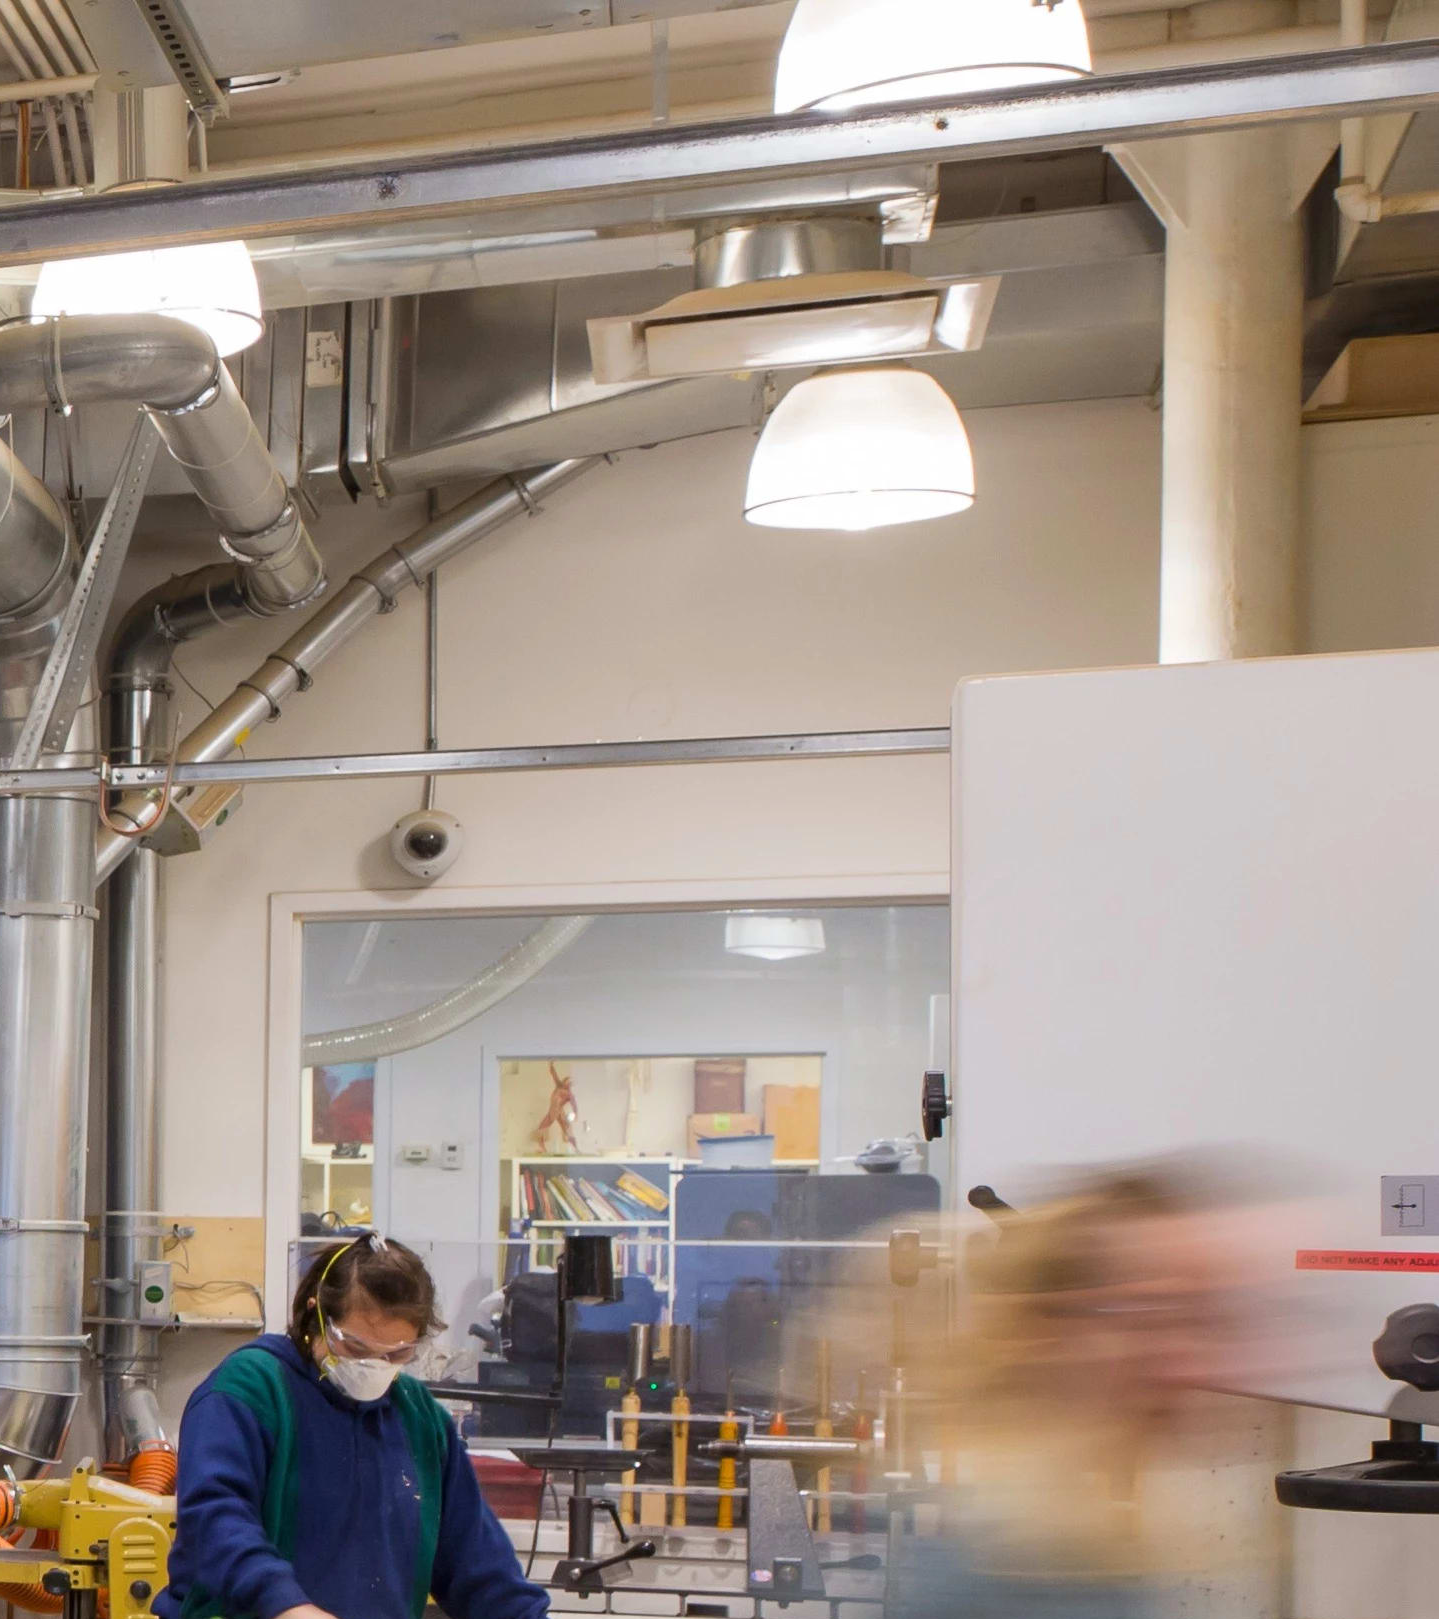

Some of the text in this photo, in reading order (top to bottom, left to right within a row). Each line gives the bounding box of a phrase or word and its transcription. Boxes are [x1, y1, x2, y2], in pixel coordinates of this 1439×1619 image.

[1300, 1255, 1318, 1265] DO
[1321, 1256, 1344, 1265] NOT
[1348, 1257, 1379, 1265] MAKE
[1383, 1257, 1406, 1266] ANY
